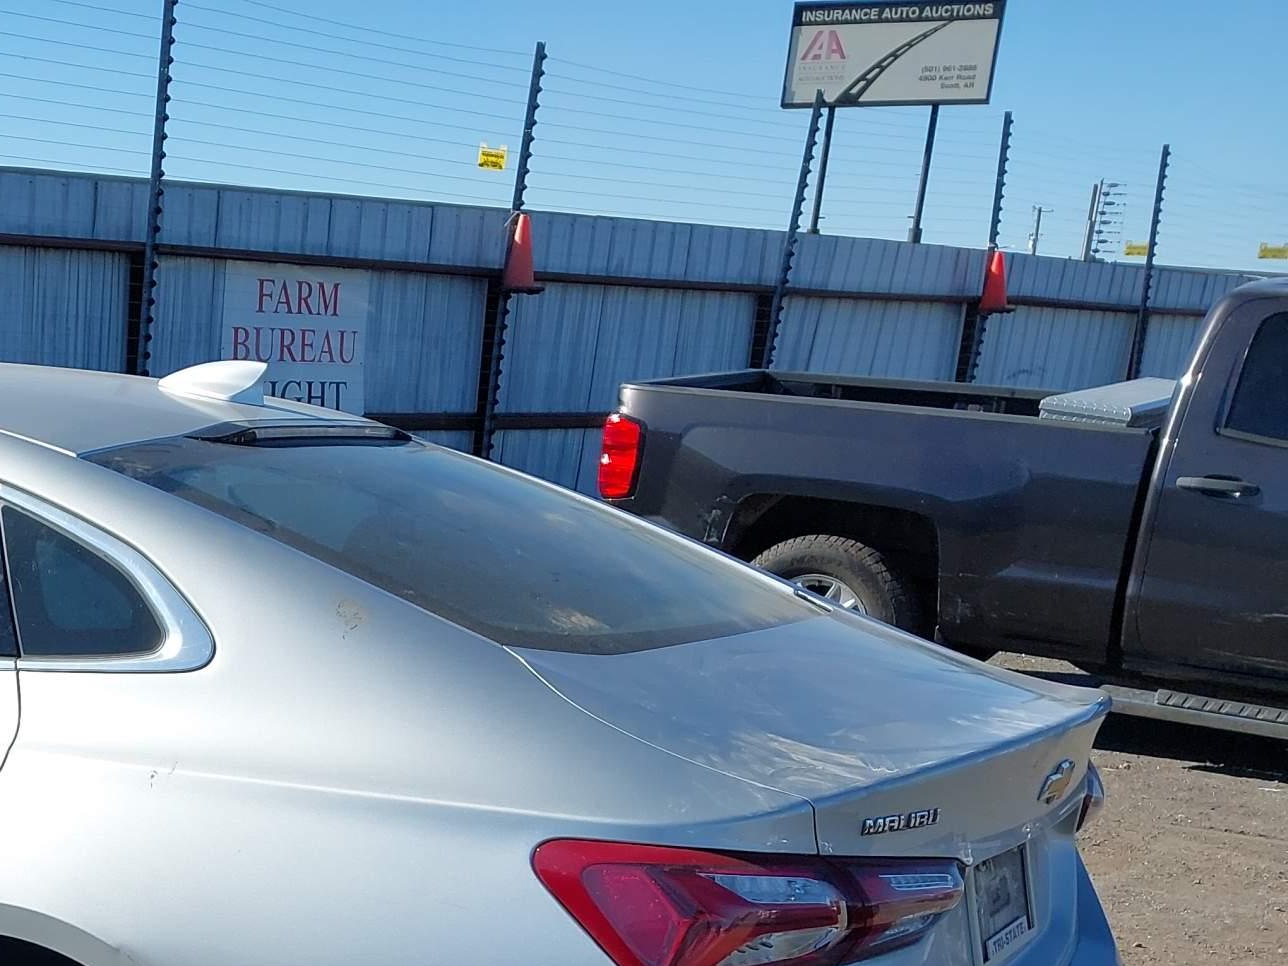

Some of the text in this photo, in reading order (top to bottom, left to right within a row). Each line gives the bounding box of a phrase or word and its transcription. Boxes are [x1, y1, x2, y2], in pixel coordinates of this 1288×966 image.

[802, 3, 994, 22] INSURANCE AUTO AUCTIONS
[256, 279, 341, 316] FARM
[232, 327, 359, 364] BUREAU
[861, 808, 942, 836] MALIBU
